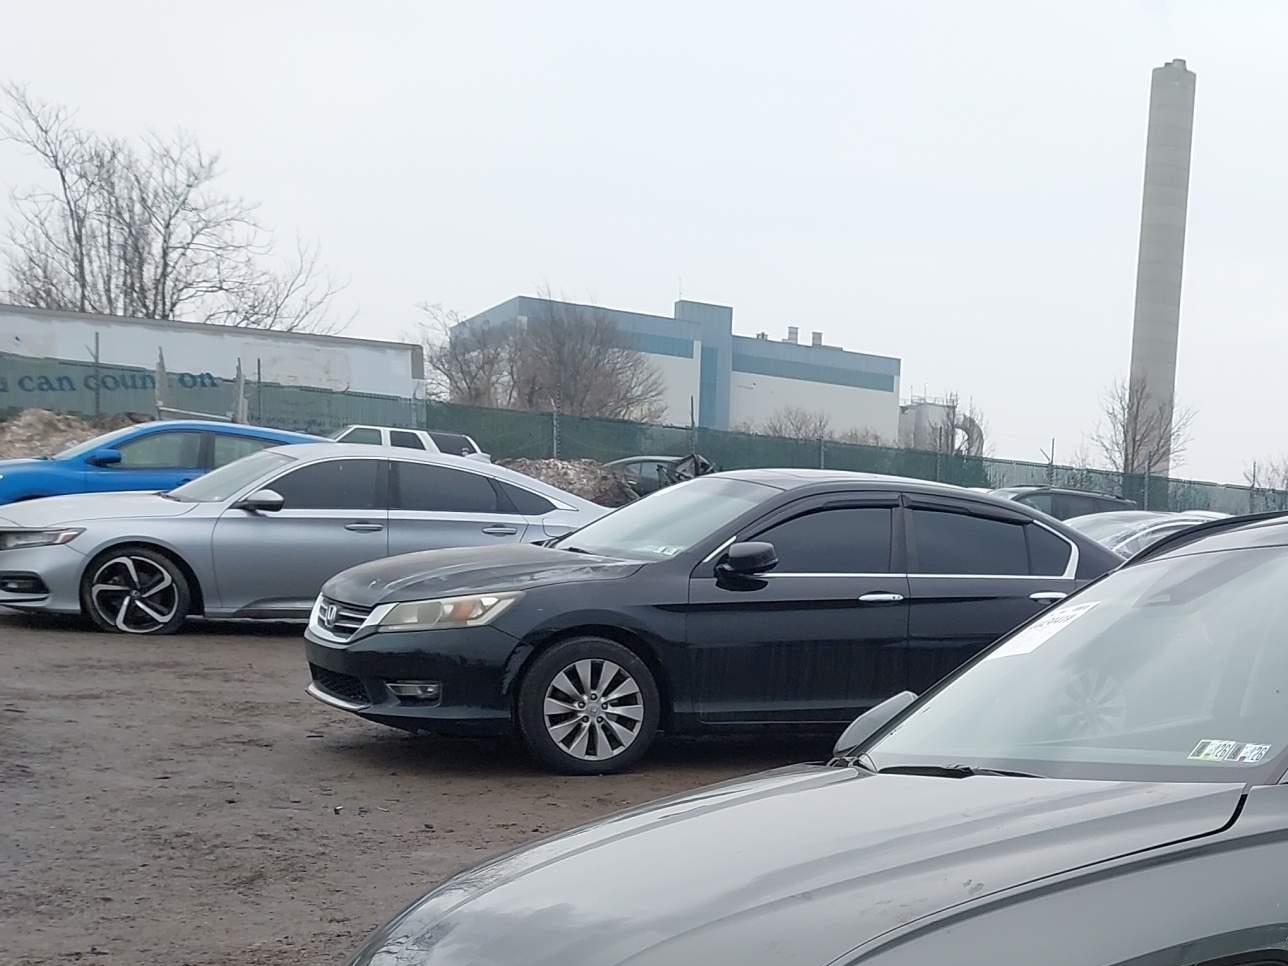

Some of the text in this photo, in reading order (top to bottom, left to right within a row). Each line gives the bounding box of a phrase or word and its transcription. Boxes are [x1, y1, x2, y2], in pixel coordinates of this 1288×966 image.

[17, 374, 76, 392] can
[83, 374, 158, 391] coun
[178, 372, 218, 388] on
